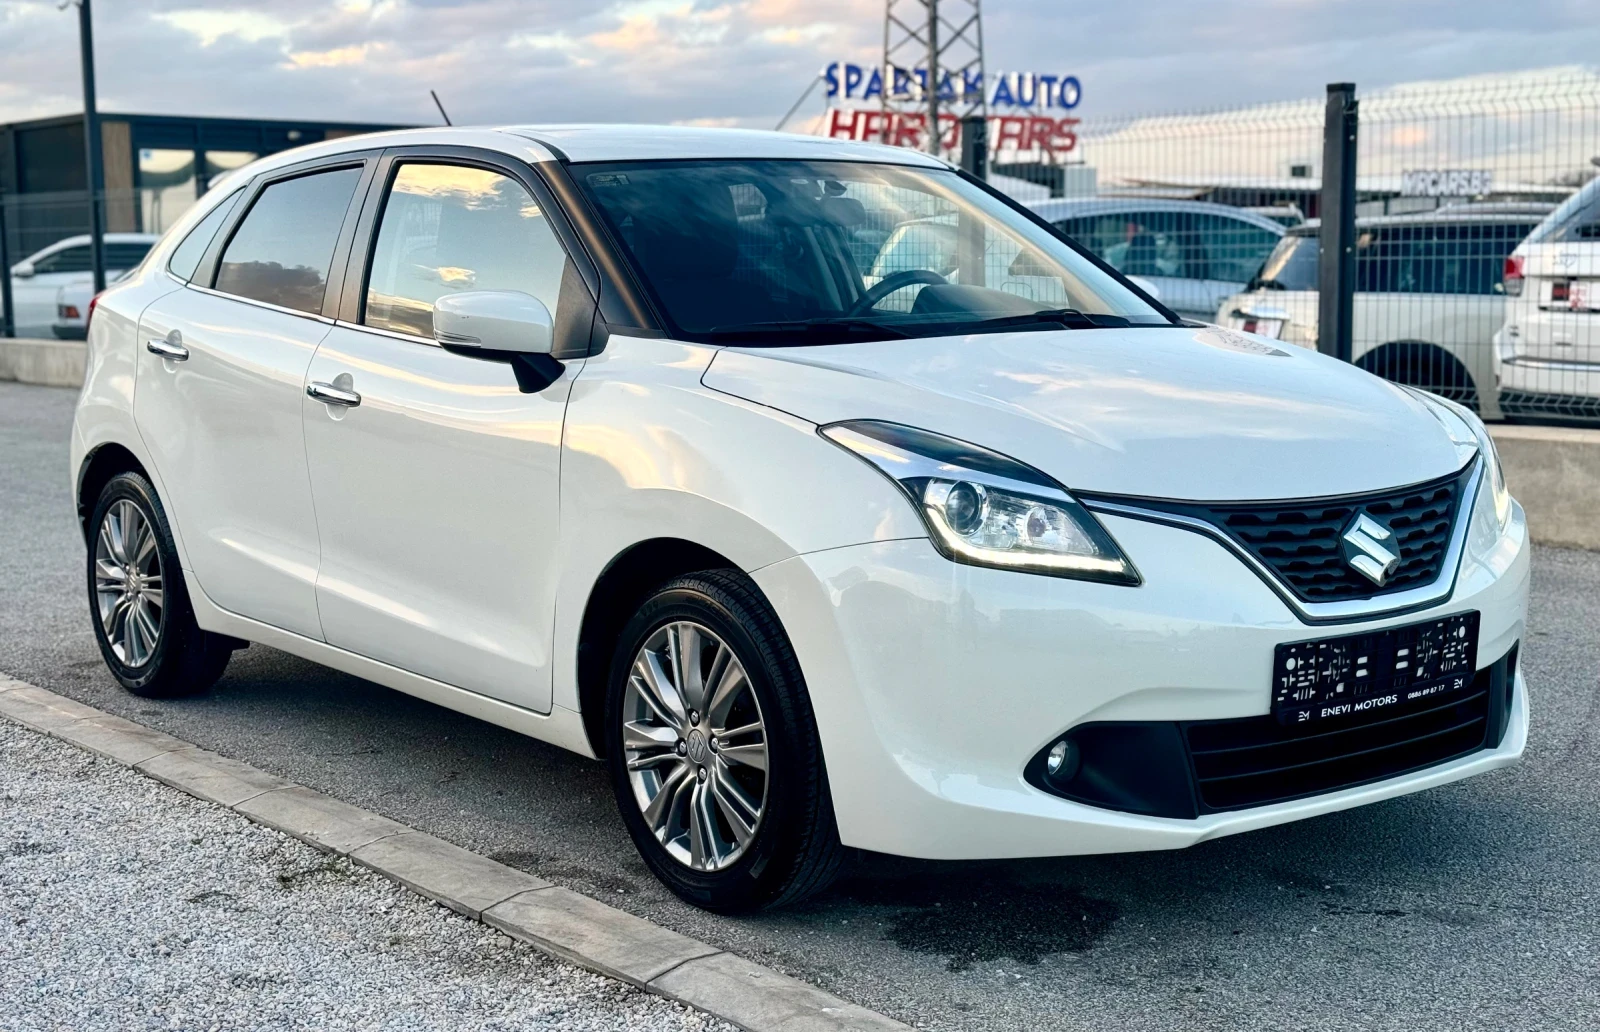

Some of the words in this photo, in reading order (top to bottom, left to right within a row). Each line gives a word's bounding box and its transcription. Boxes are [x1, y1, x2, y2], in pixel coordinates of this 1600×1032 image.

[825, 62, 984, 105] SPARTAK
[991, 74, 1082, 110] AUTO
[1321, 703, 1351, 718] ENEVI
[1354, 694, 1398, 712] MOTORS
